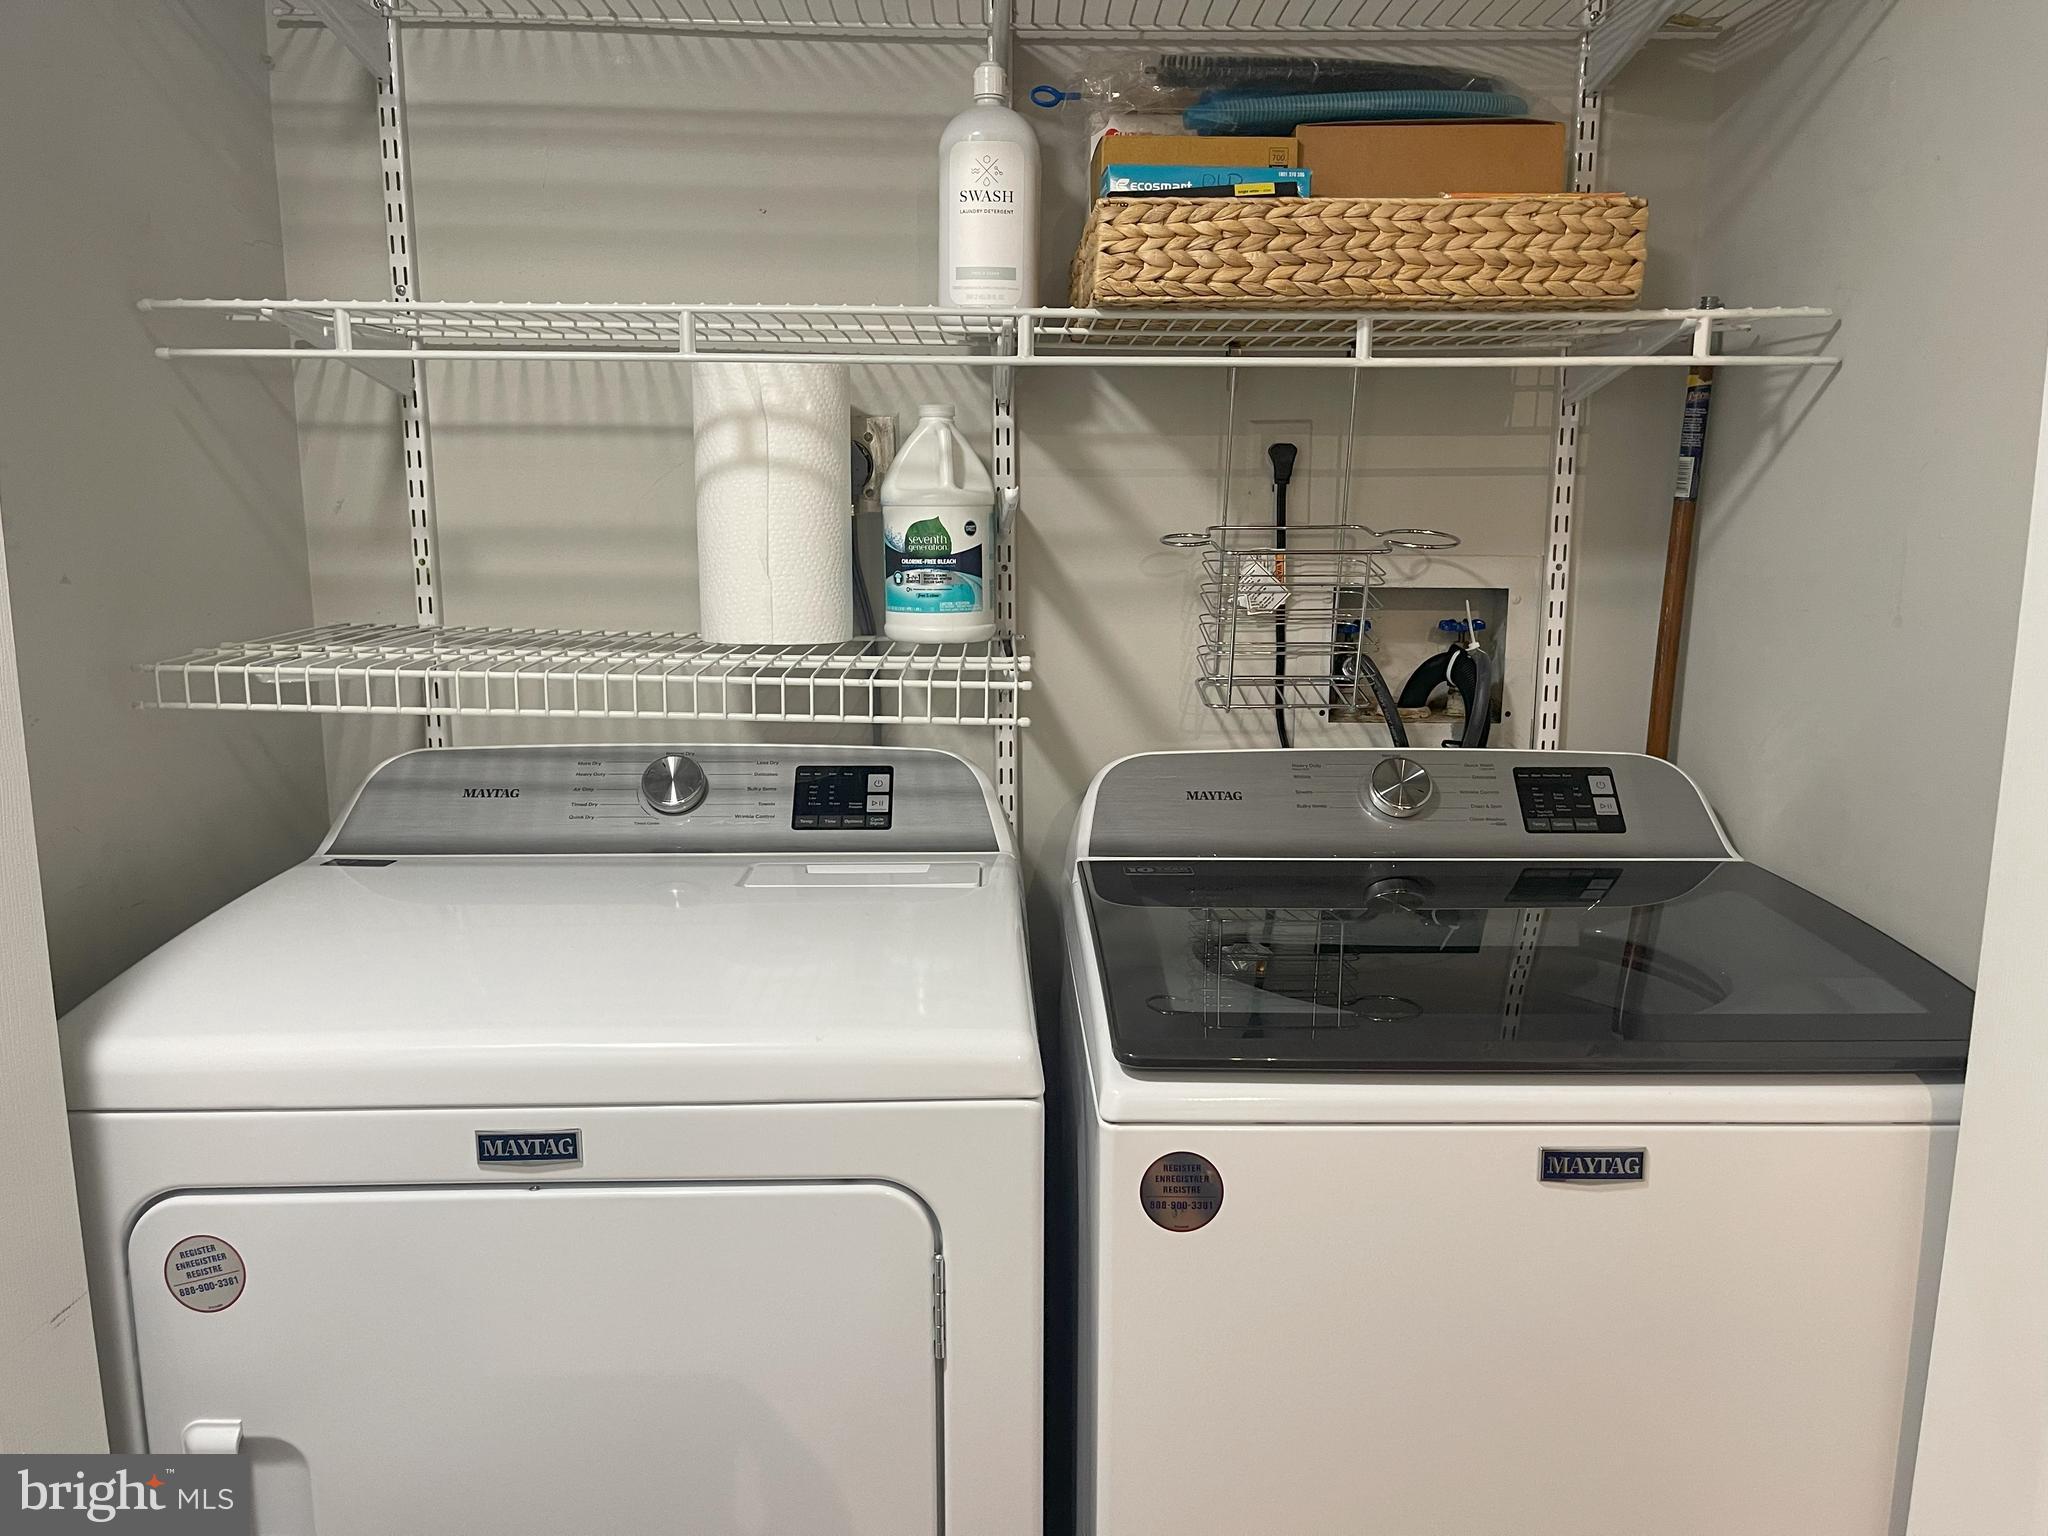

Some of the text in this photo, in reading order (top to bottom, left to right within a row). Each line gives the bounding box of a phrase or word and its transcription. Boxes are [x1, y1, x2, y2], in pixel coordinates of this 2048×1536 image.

[959, 190, 1014, 203] SWASH
[908, 534, 948, 545] seventh
[908, 544, 948, 552] generation
[462, 788, 520, 798] MAYTAG
[1185, 790, 1243, 801] MAYTAG
[482, 1137, 574, 1157] MAYTAG
[1163, 1164, 1201, 1172] REGISTER
[1546, 1156, 1641, 1174] MAYTAG
[1155, 1175, 1210, 1183] ENREGISTRER
[1163, 1186, 1201, 1194] REGISTRE
[179, 1244, 217, 1259] REGISTER
[175, 1252, 227, 1271] ENREGISTRER
[186, 1264, 223, 1279] REGISTRE
[179, 1275, 239, 1297] 888-900-3381
